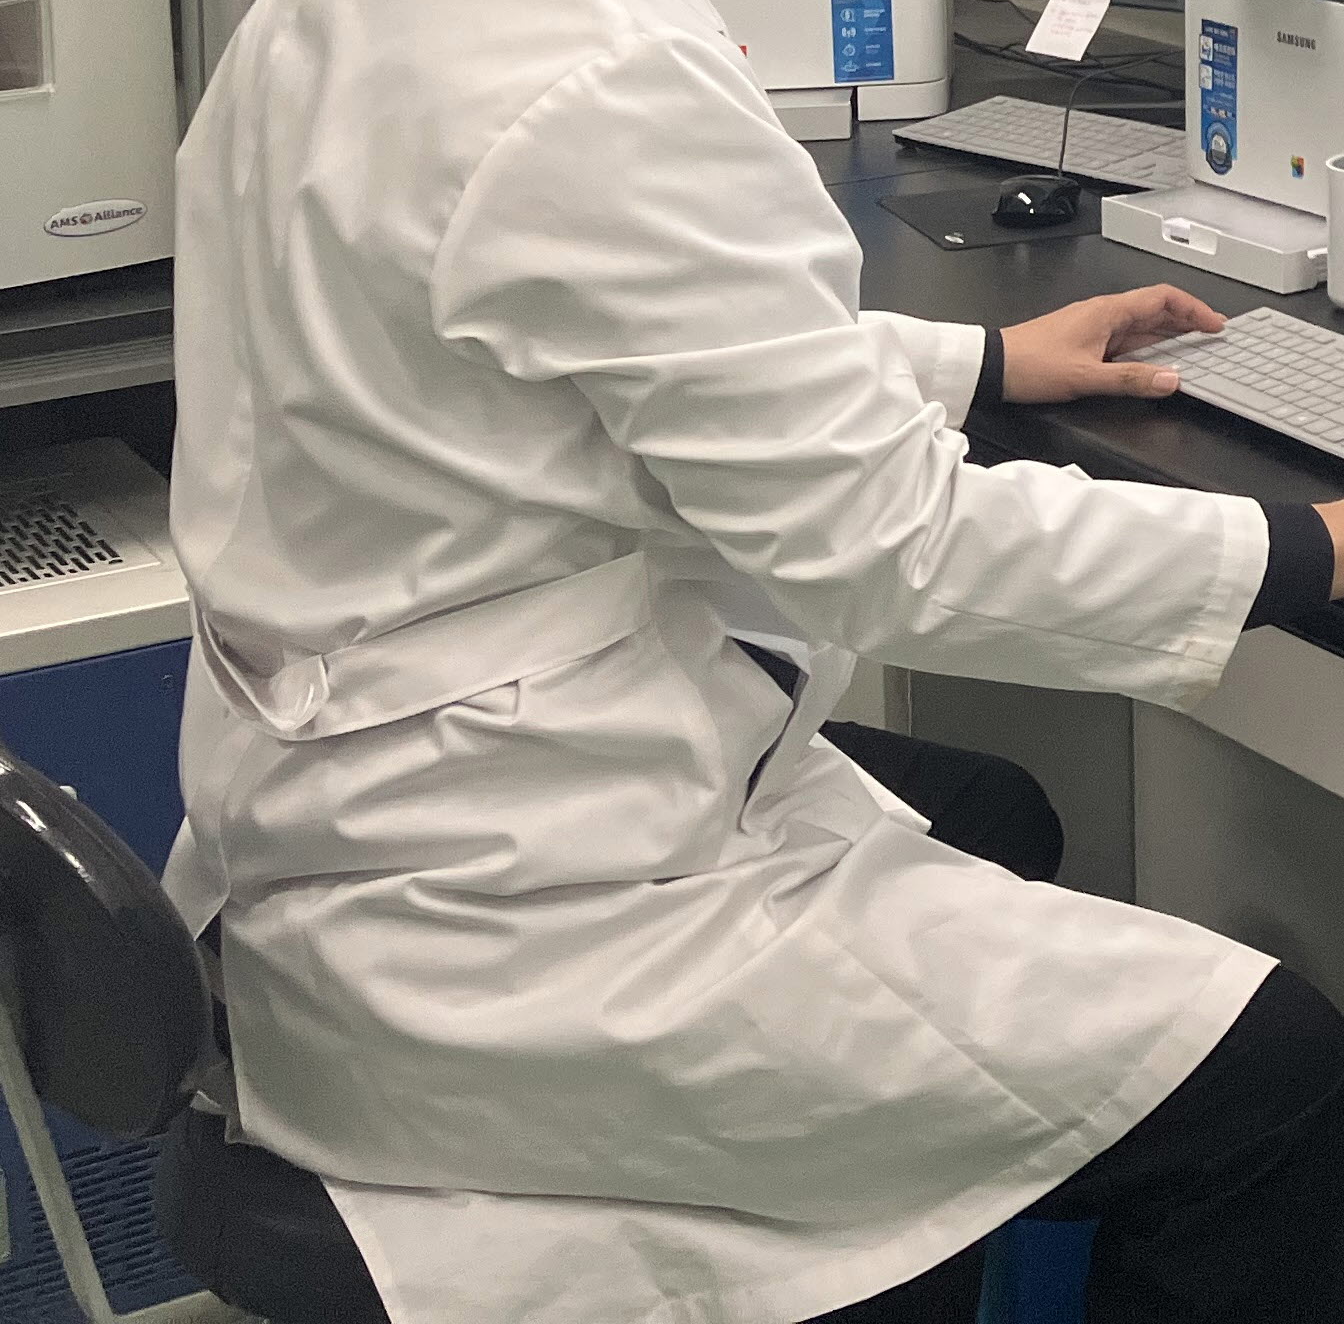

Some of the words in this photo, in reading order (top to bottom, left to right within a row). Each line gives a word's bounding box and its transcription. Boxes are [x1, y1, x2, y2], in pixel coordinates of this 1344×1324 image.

[1276, 31, 1316, 50] SAMSUNG
[50, 216, 78, 230] AMS
[94, 207, 143, 222] Alliance
